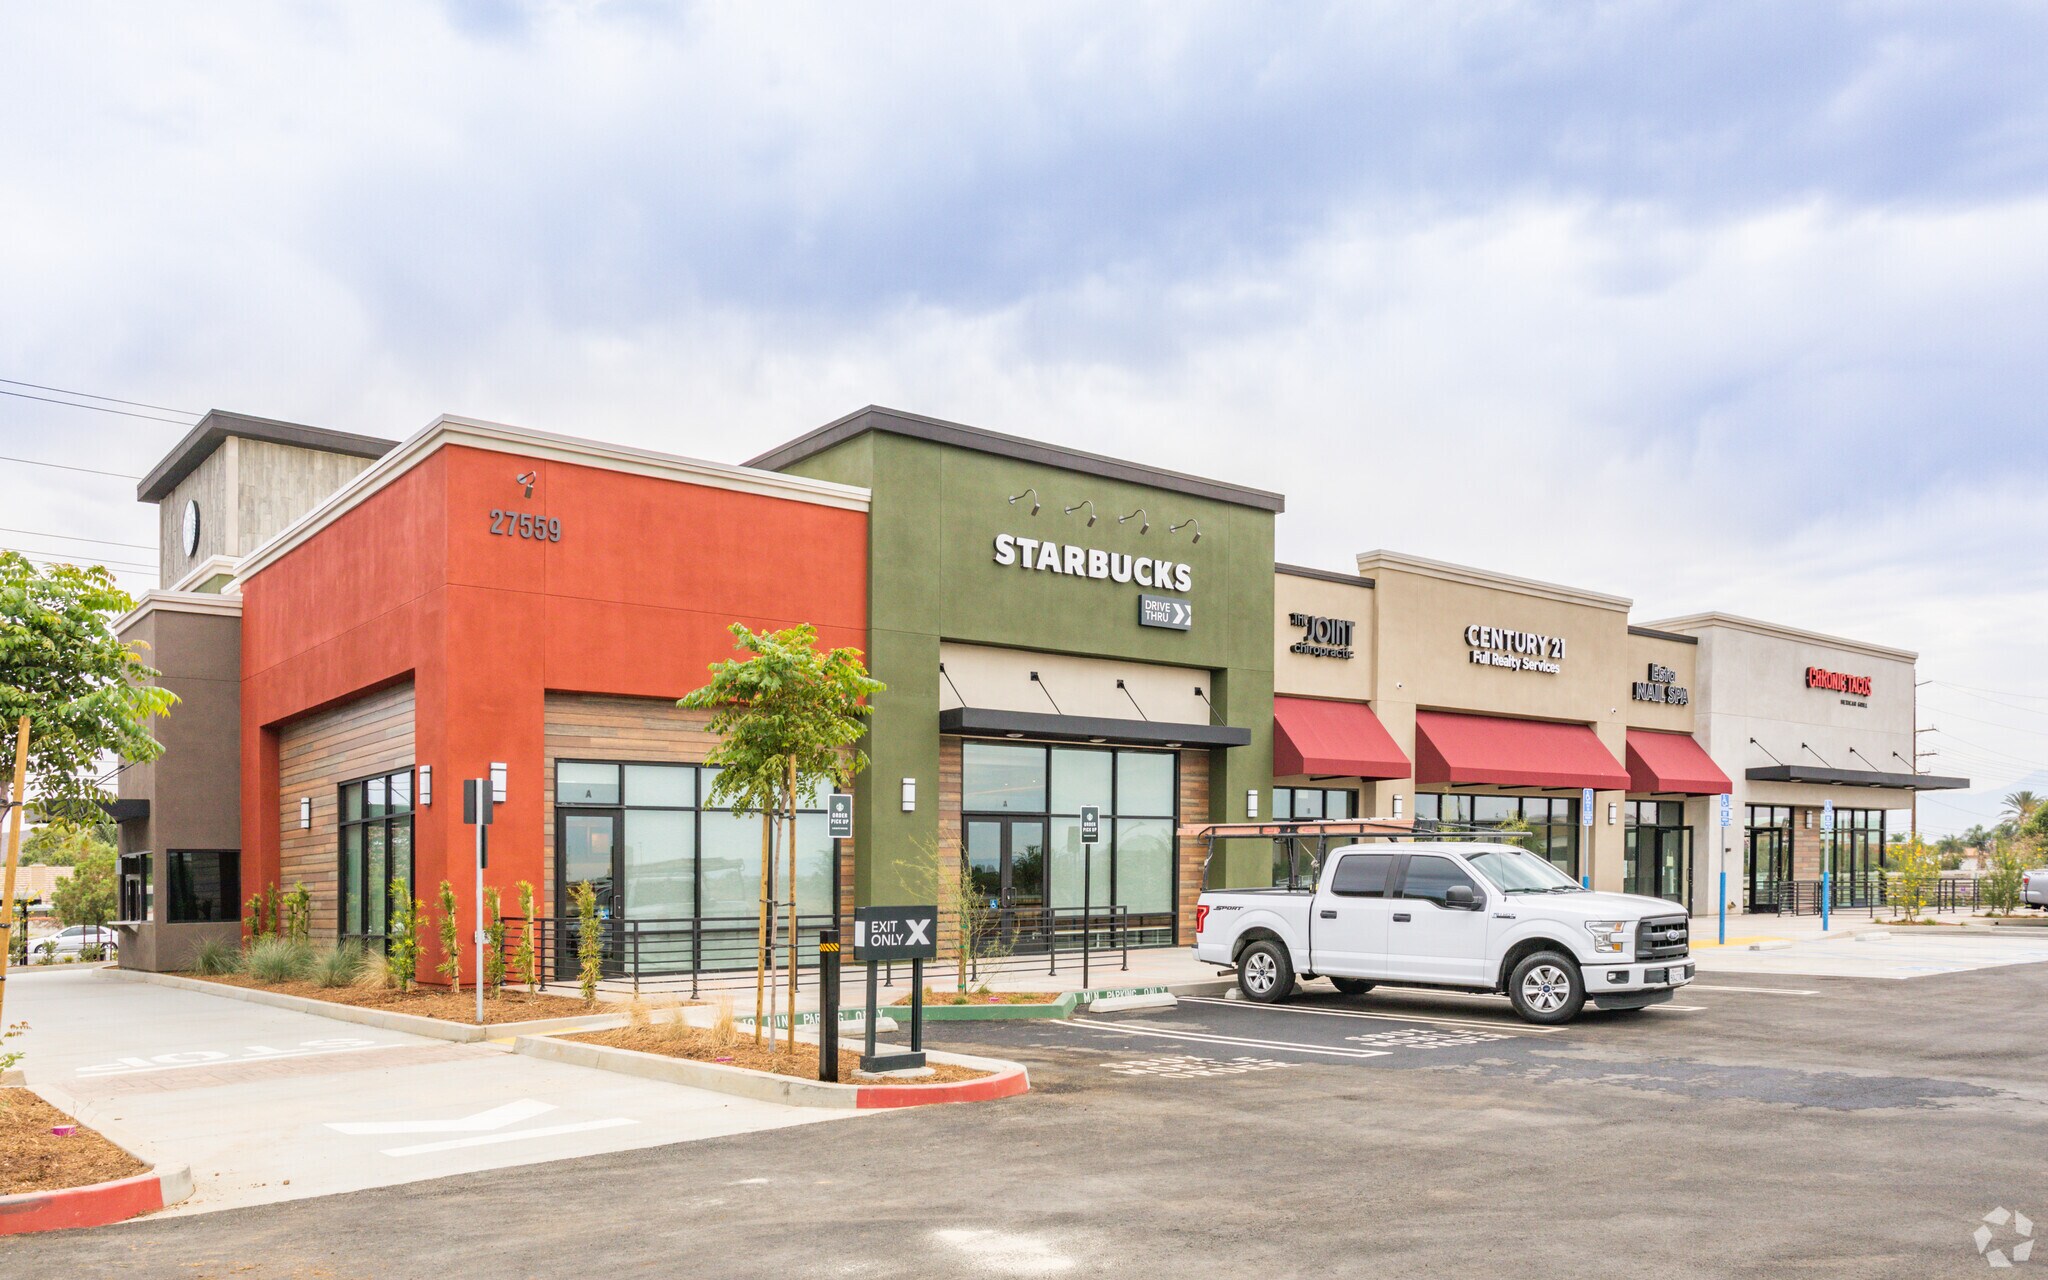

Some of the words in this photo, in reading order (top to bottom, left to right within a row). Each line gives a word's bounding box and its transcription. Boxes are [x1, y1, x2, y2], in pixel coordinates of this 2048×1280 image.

[490, 509, 562, 542] 27559
[994, 534, 1192, 592] STARBUCKS
[1145, 600, 1171, 613] DRIVE
[1145, 611, 1169, 623] THRU
[1304, 616, 1355, 646] JOINT
[1291, 642, 1354, 660] chiropractic
[1466, 624, 1549, 656] CENTURY
[1550, 637, 1566, 659] 21
[1470, 650, 1490, 664] Full
[1492, 652, 1521, 671] Realty
[1522, 657, 1560, 674] Services
[1648, 663, 1676, 683] Esta
[1633, 682, 1665, 702] NAIL
[1665, 686, 1688, 705] SPA
[1847, 675, 1872, 697] TACOS
[585, 789, 592, 799] A
[871, 920, 898, 933] EXIT
[871, 933, 904, 947] ONLY
[1083, 991, 1100, 1003] MIN
[1106, 989, 1137, 999] PARKING
[1144, 986, 1165, 995] ONLY
[803, 1011, 844, 1025] PARG
[855, 1009, 884, 1020] OY
[75, 1038, 375, 1072] STOP
